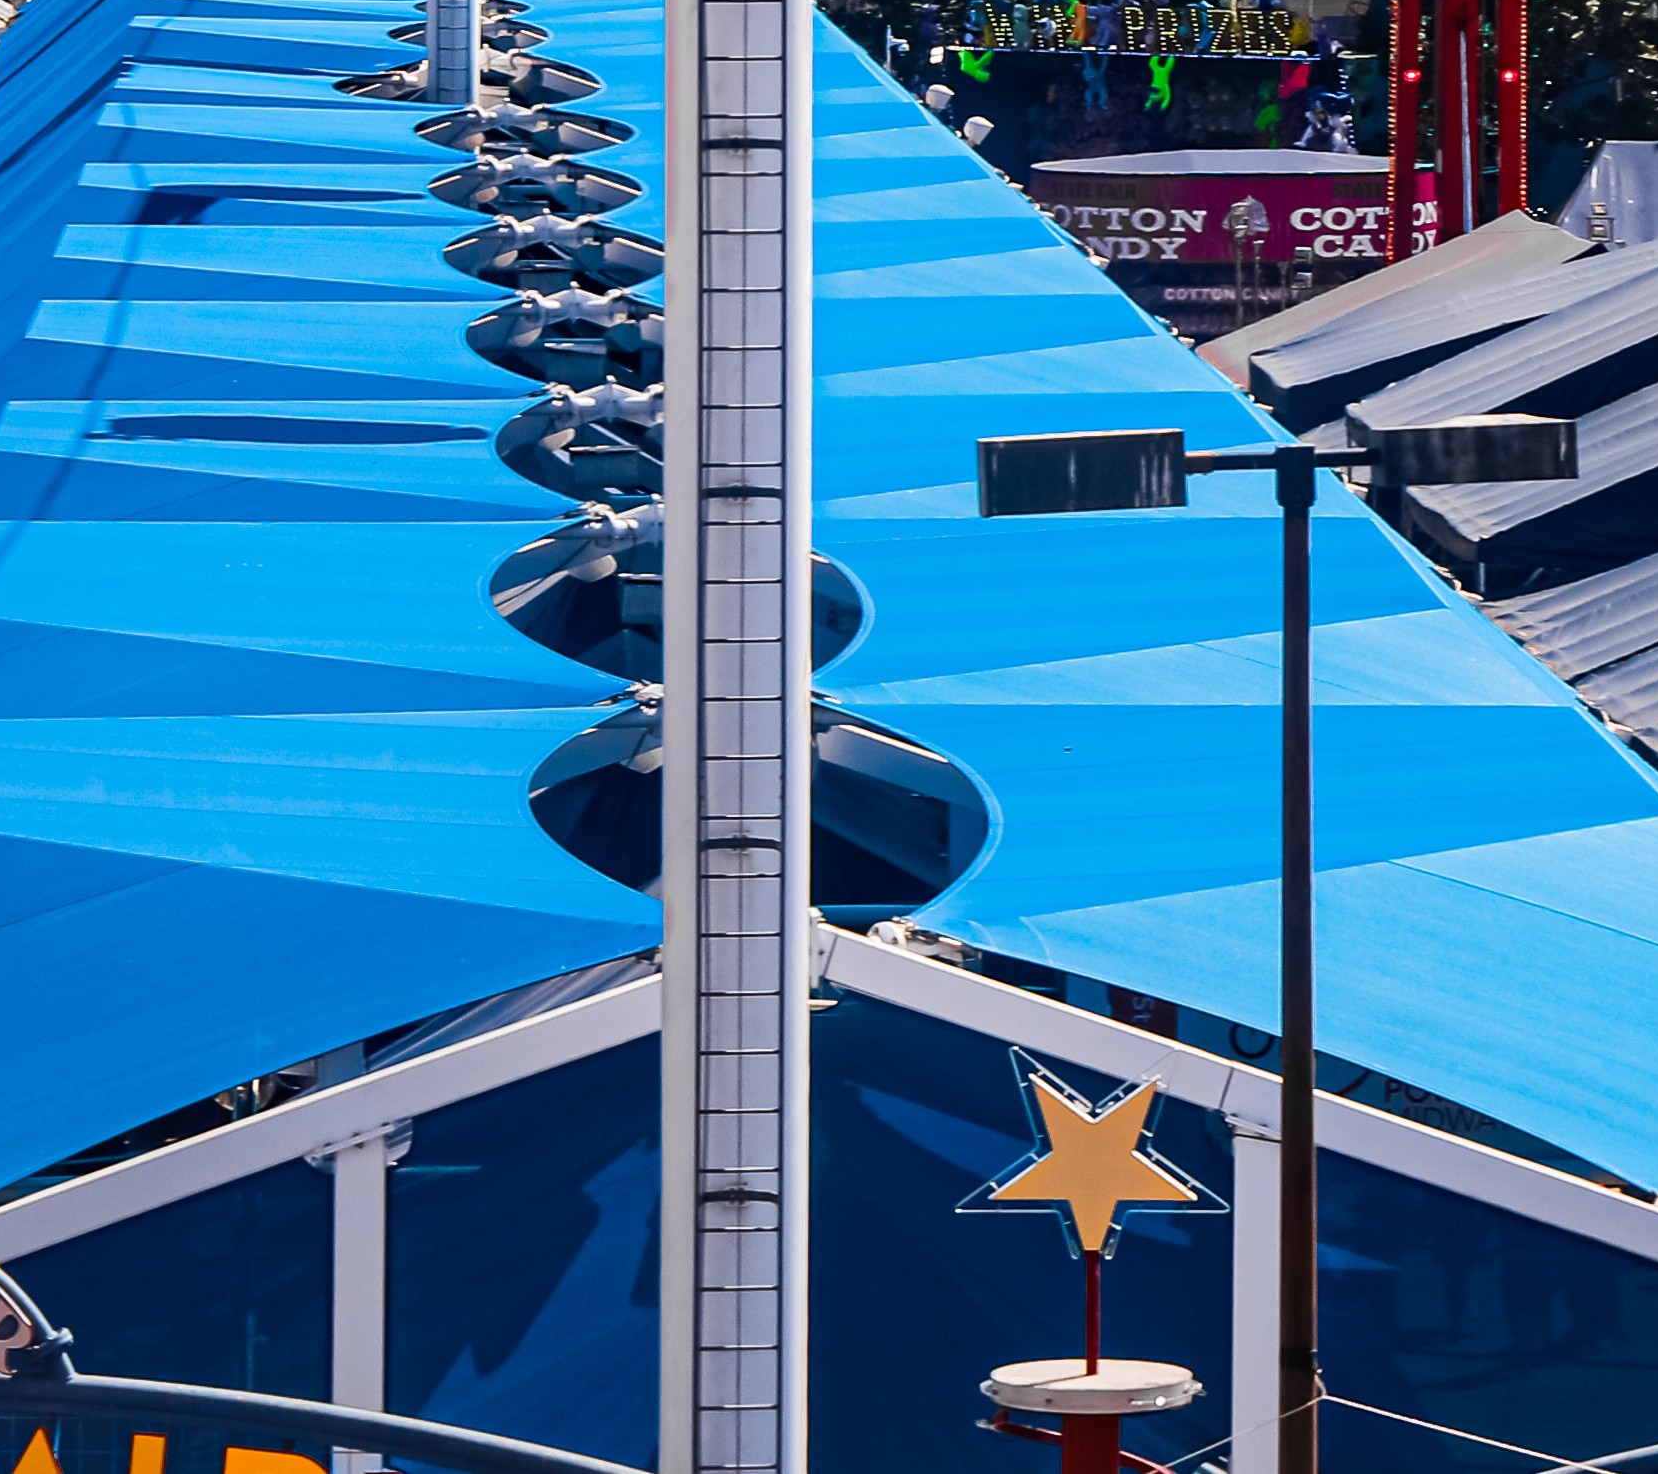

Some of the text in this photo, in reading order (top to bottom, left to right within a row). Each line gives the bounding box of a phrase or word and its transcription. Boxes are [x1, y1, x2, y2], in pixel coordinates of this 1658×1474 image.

[1124, 7, 1293, 55] PRIZES
[1044, 204, 1208, 234] OTTON
[1163, 287, 1236, 302] COTTON
